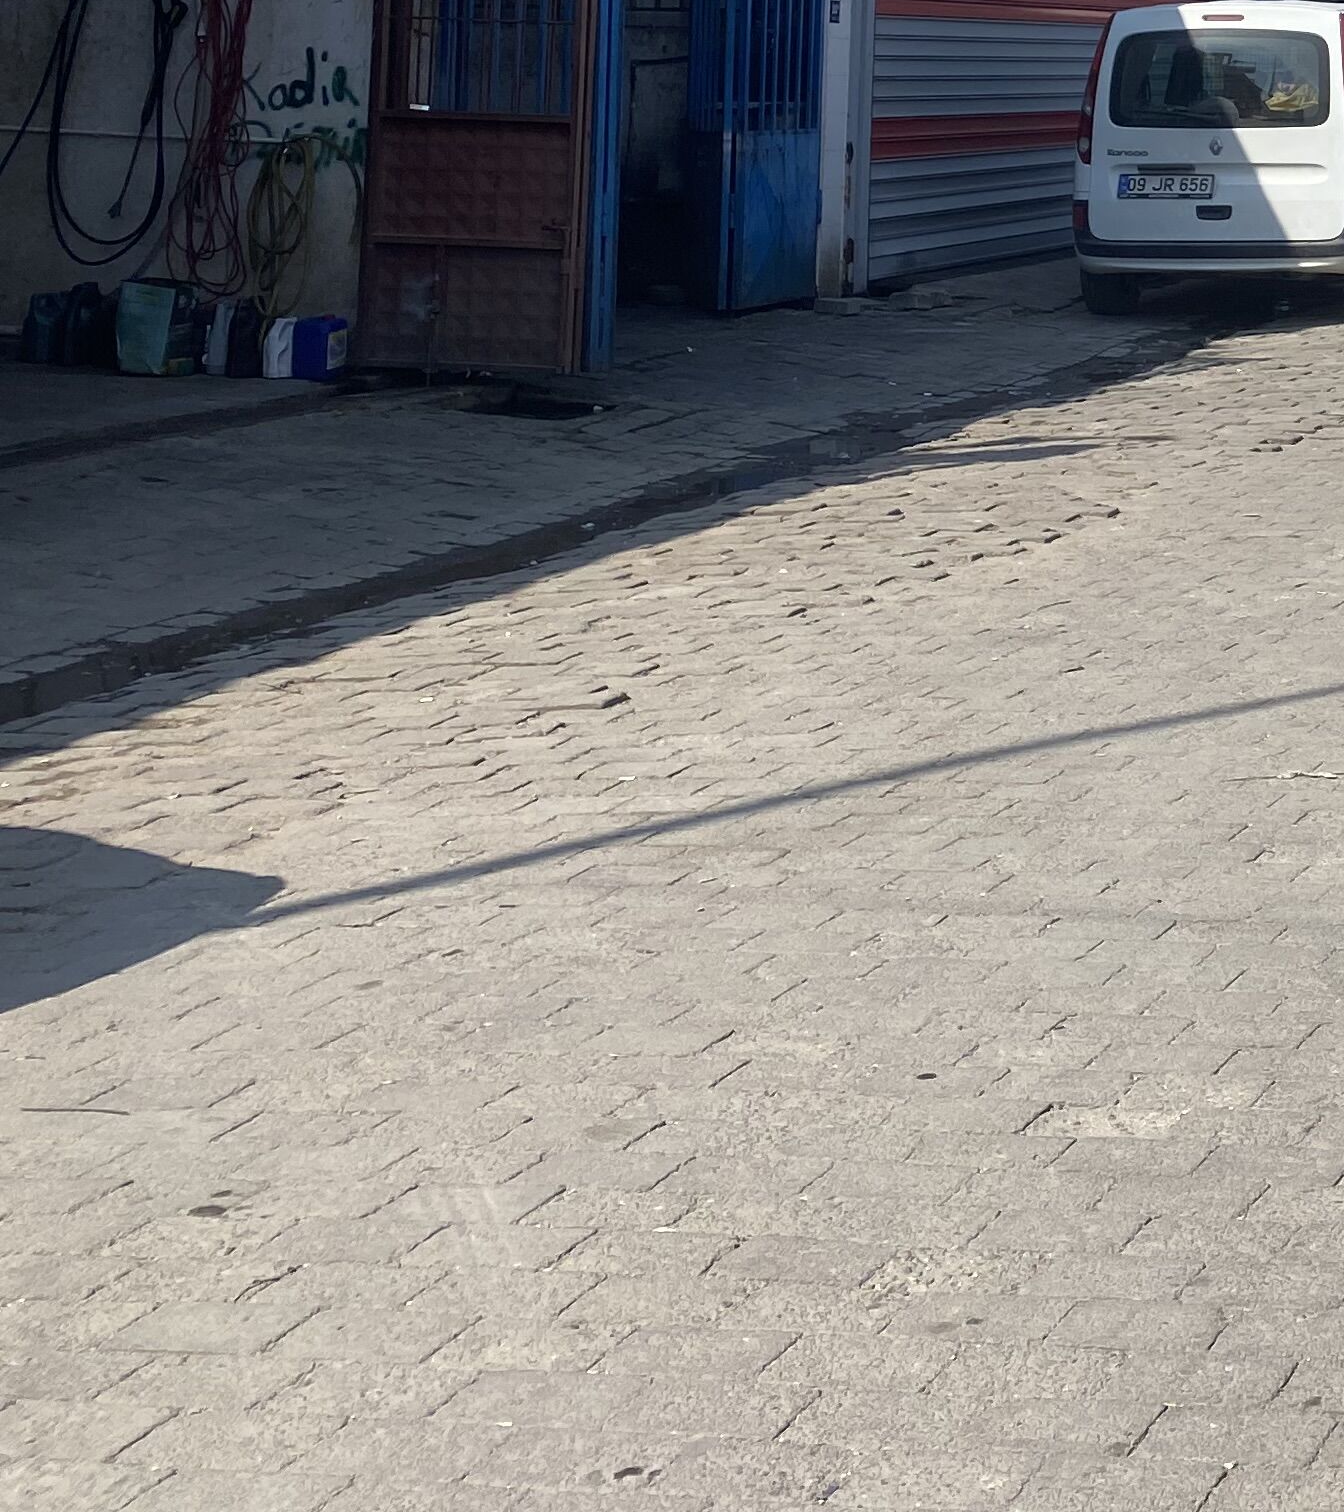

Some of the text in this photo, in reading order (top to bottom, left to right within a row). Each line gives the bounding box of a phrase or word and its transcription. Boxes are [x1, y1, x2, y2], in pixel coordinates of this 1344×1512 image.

[1127, 177, 1209, 192] 09 JR 656
